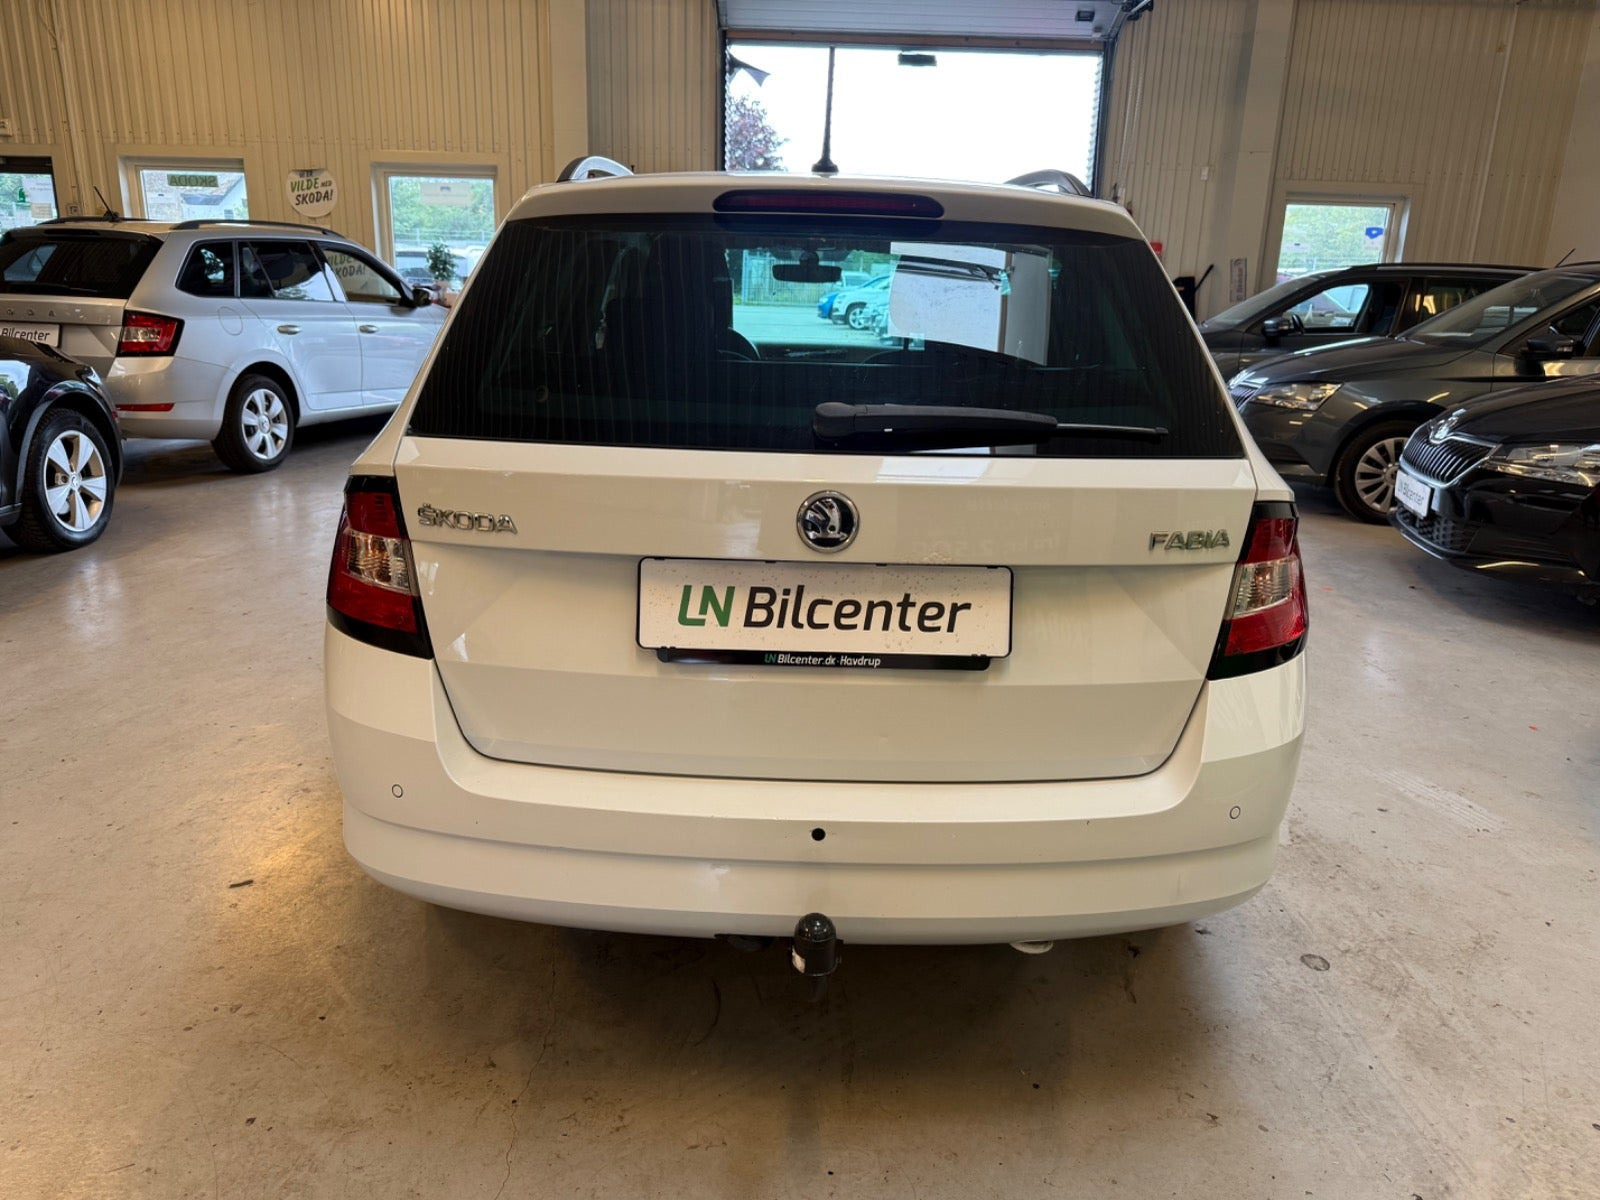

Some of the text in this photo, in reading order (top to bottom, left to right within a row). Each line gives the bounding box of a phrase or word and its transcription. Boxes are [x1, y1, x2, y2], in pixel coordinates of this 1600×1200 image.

[290, 177, 320, 193] VILDE
[295, 189, 333, 206] SKODA!
[335, 264, 366, 279] KODA!
[1149, 529, 1230, 551] FABIA
[677, 584, 972, 634] LN Bilcenter
[840, 655, 881, 668] Havdrup
